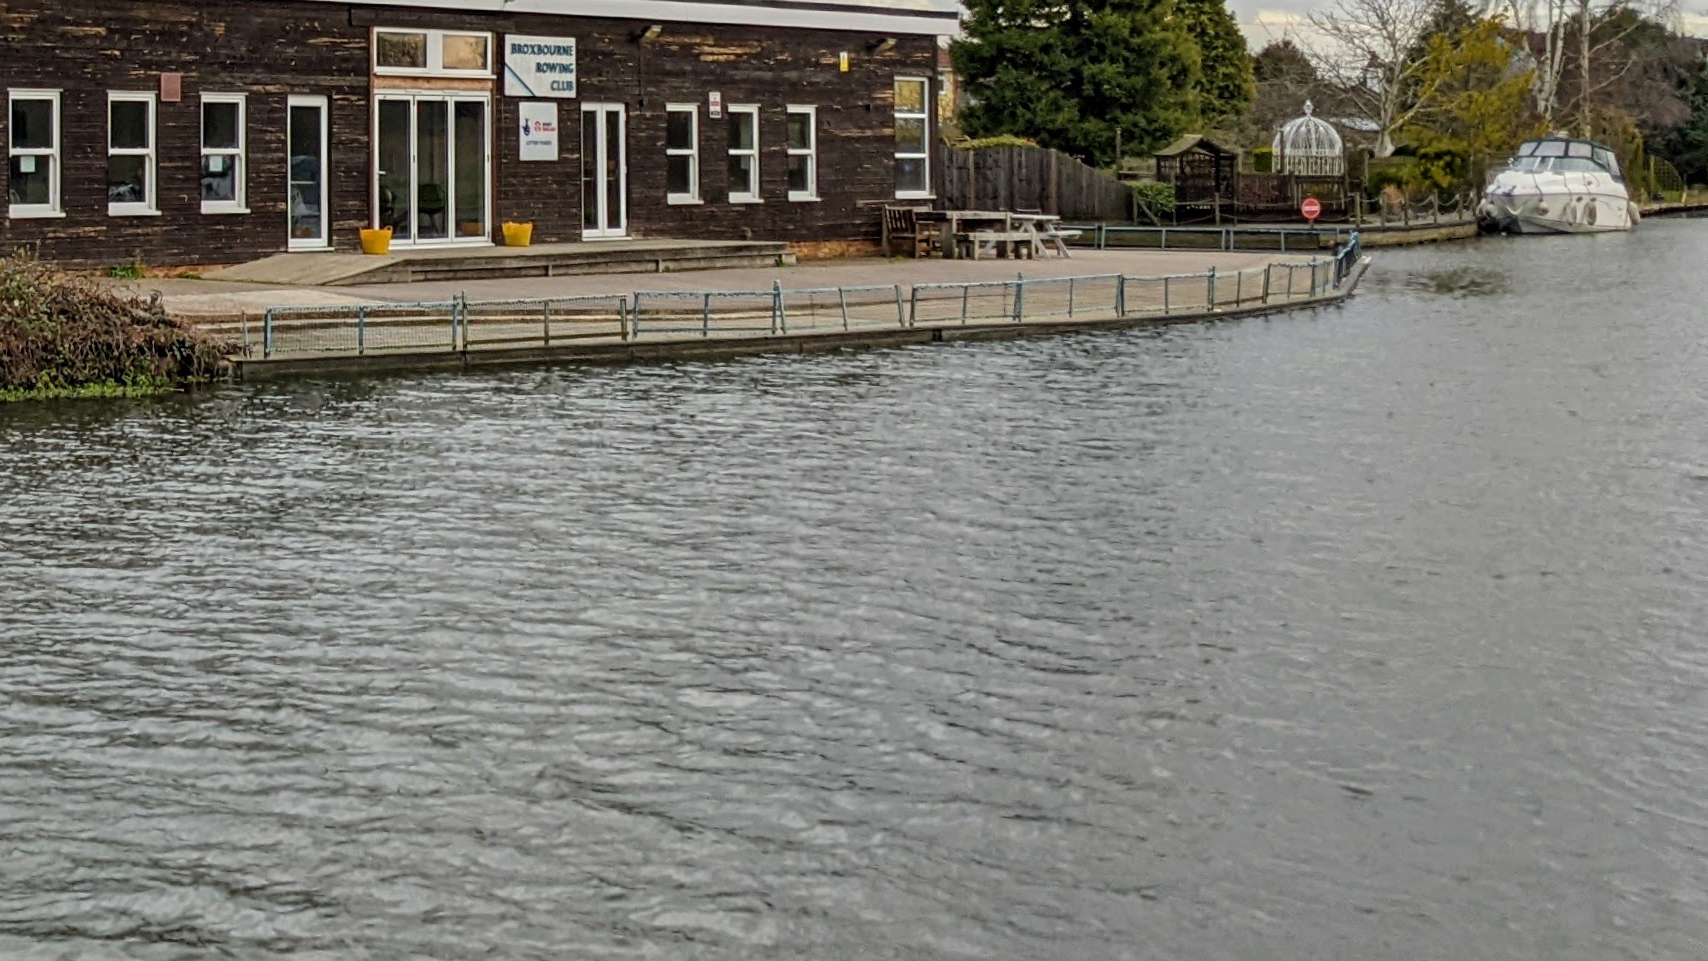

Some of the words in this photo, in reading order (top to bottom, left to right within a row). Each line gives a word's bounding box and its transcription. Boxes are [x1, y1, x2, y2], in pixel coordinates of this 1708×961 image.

[510, 43, 574, 56] BROXBOURNE
[535, 62, 574, 73] ROWING
[550, 80, 574, 91] CLUB
